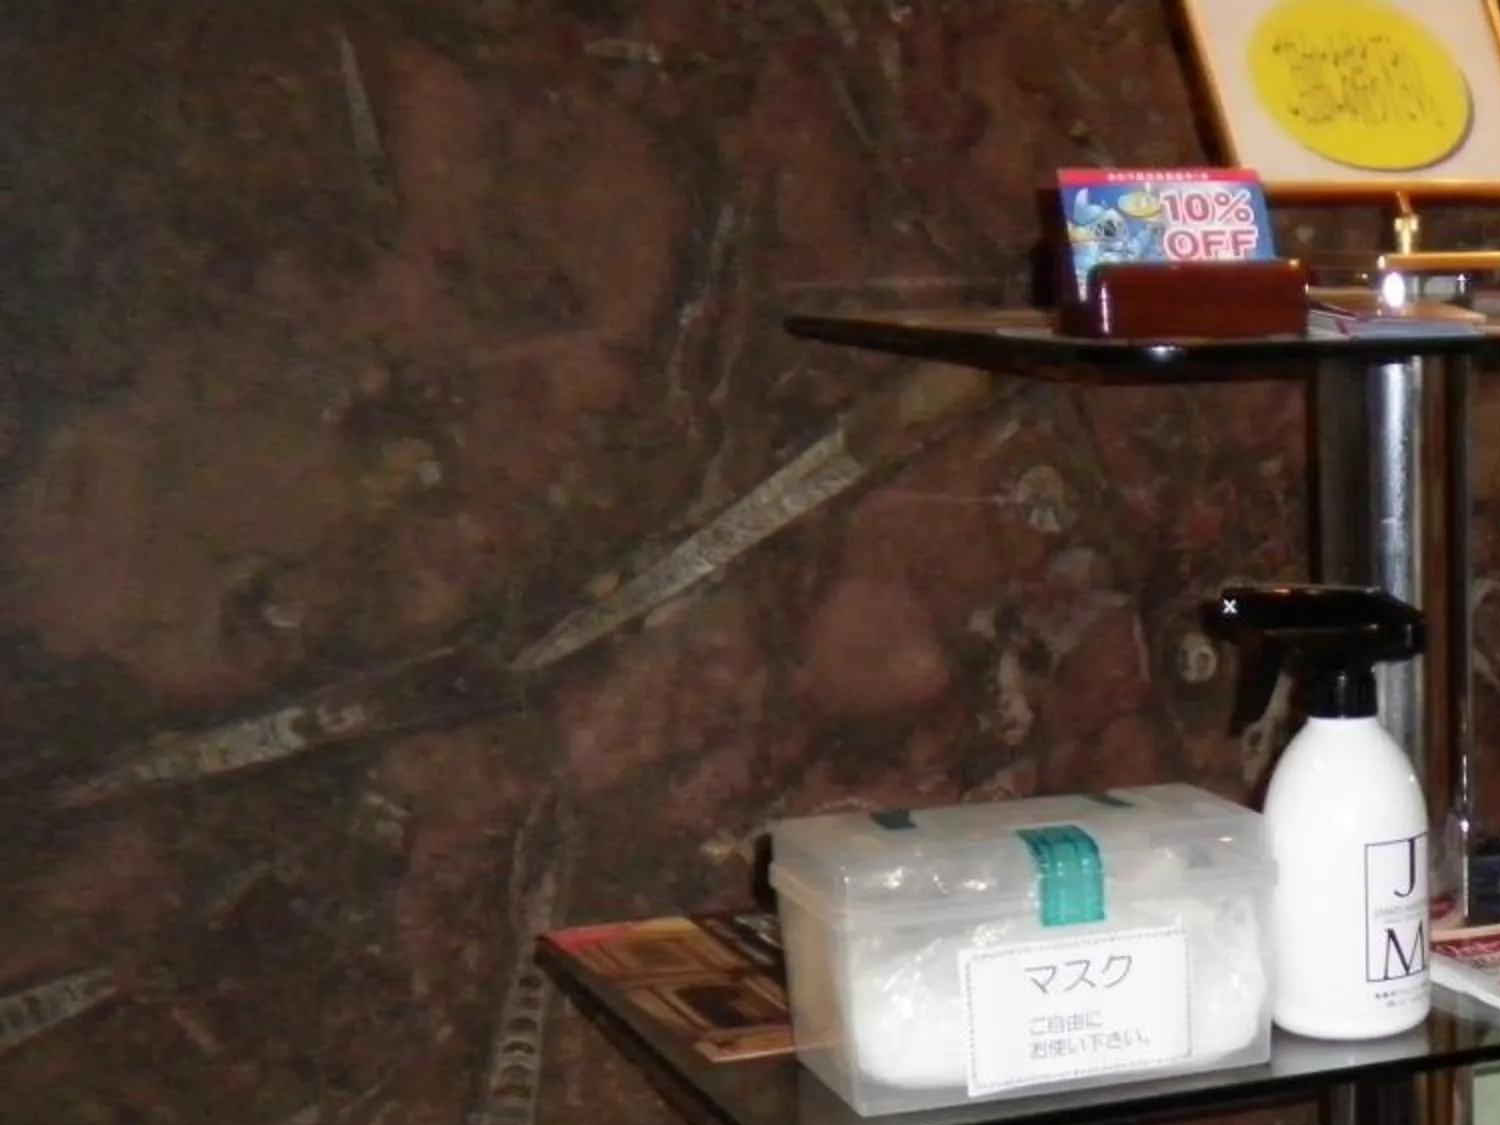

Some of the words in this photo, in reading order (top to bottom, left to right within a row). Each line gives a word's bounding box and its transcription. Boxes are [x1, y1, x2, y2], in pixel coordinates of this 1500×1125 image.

[1161, 188, 1253, 224] 10%
[1164, 227, 1258, 260] OFF
[1393, 838, 1416, 898] J
[1384, 920, 1428, 980] M
[1023, 954, 1133, 994] マスク
[1029, 1011, 1104, 1036] ご自由に
